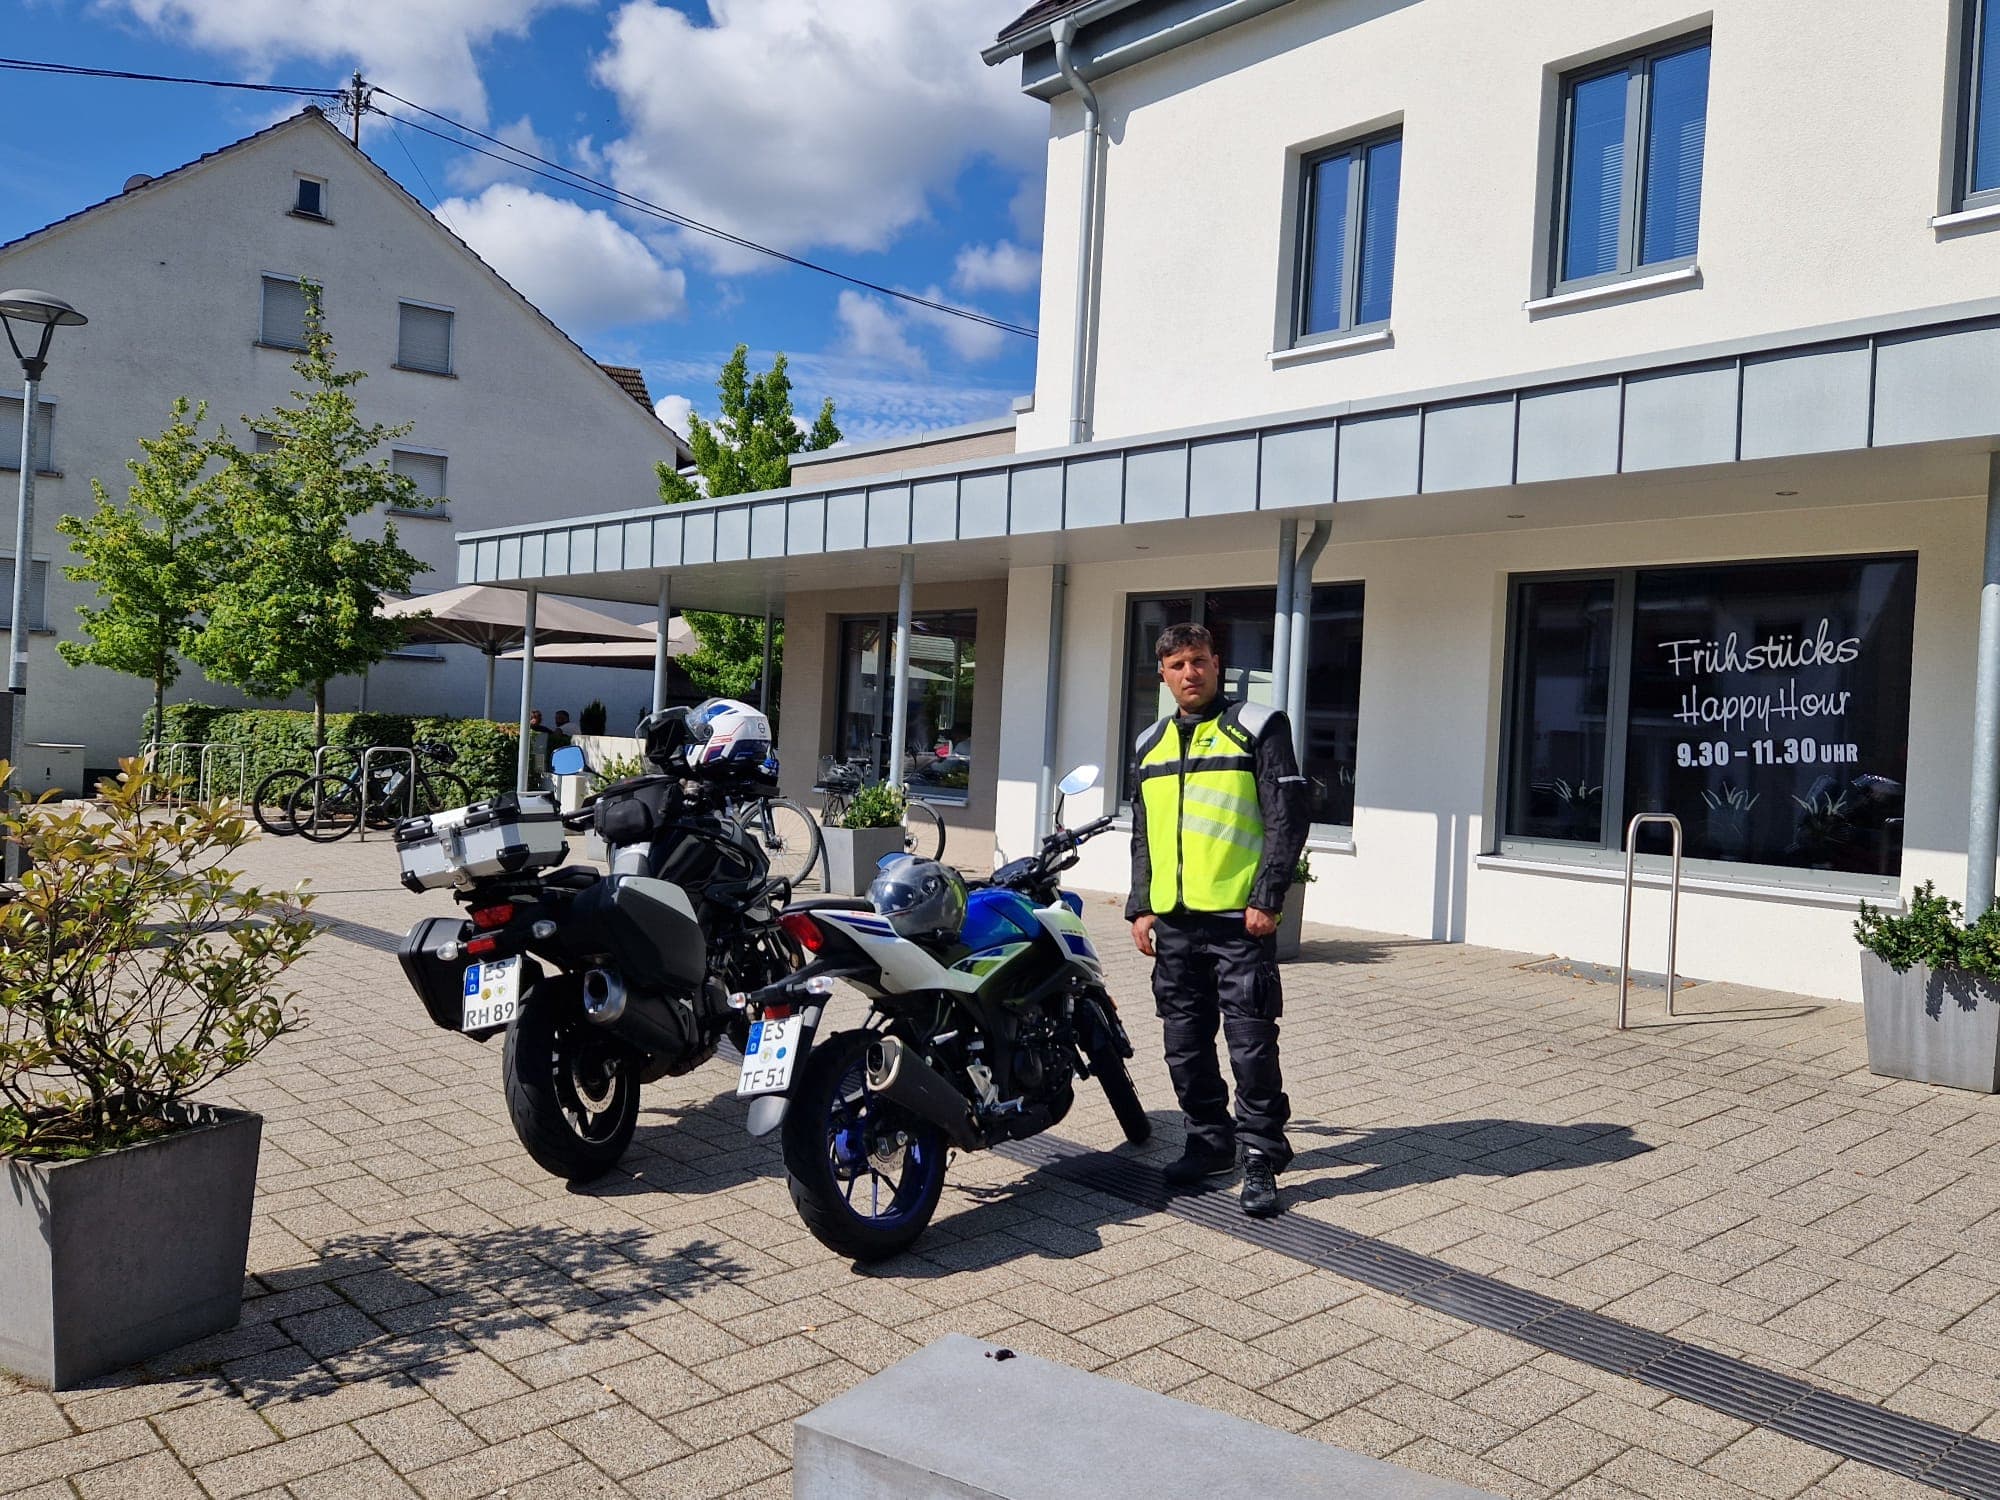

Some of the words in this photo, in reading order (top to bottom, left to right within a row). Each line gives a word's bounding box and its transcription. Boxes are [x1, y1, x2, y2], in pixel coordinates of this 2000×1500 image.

[1658, 618, 1860, 676] Frühstücks
[1677, 743, 1729, 767] 9.30
[1752, 738, 1816, 764] 11.30
[1820, 744, 1858, 763] UHR
[484, 962, 506, 982] ES
[465, 1006, 489, 1027] RH
[494, 1002, 514, 1022] 89
[763, 1021, 786, 1041] ES
[743, 1070, 763, 1090] TF
[765, 1067, 785, 1088] 51
